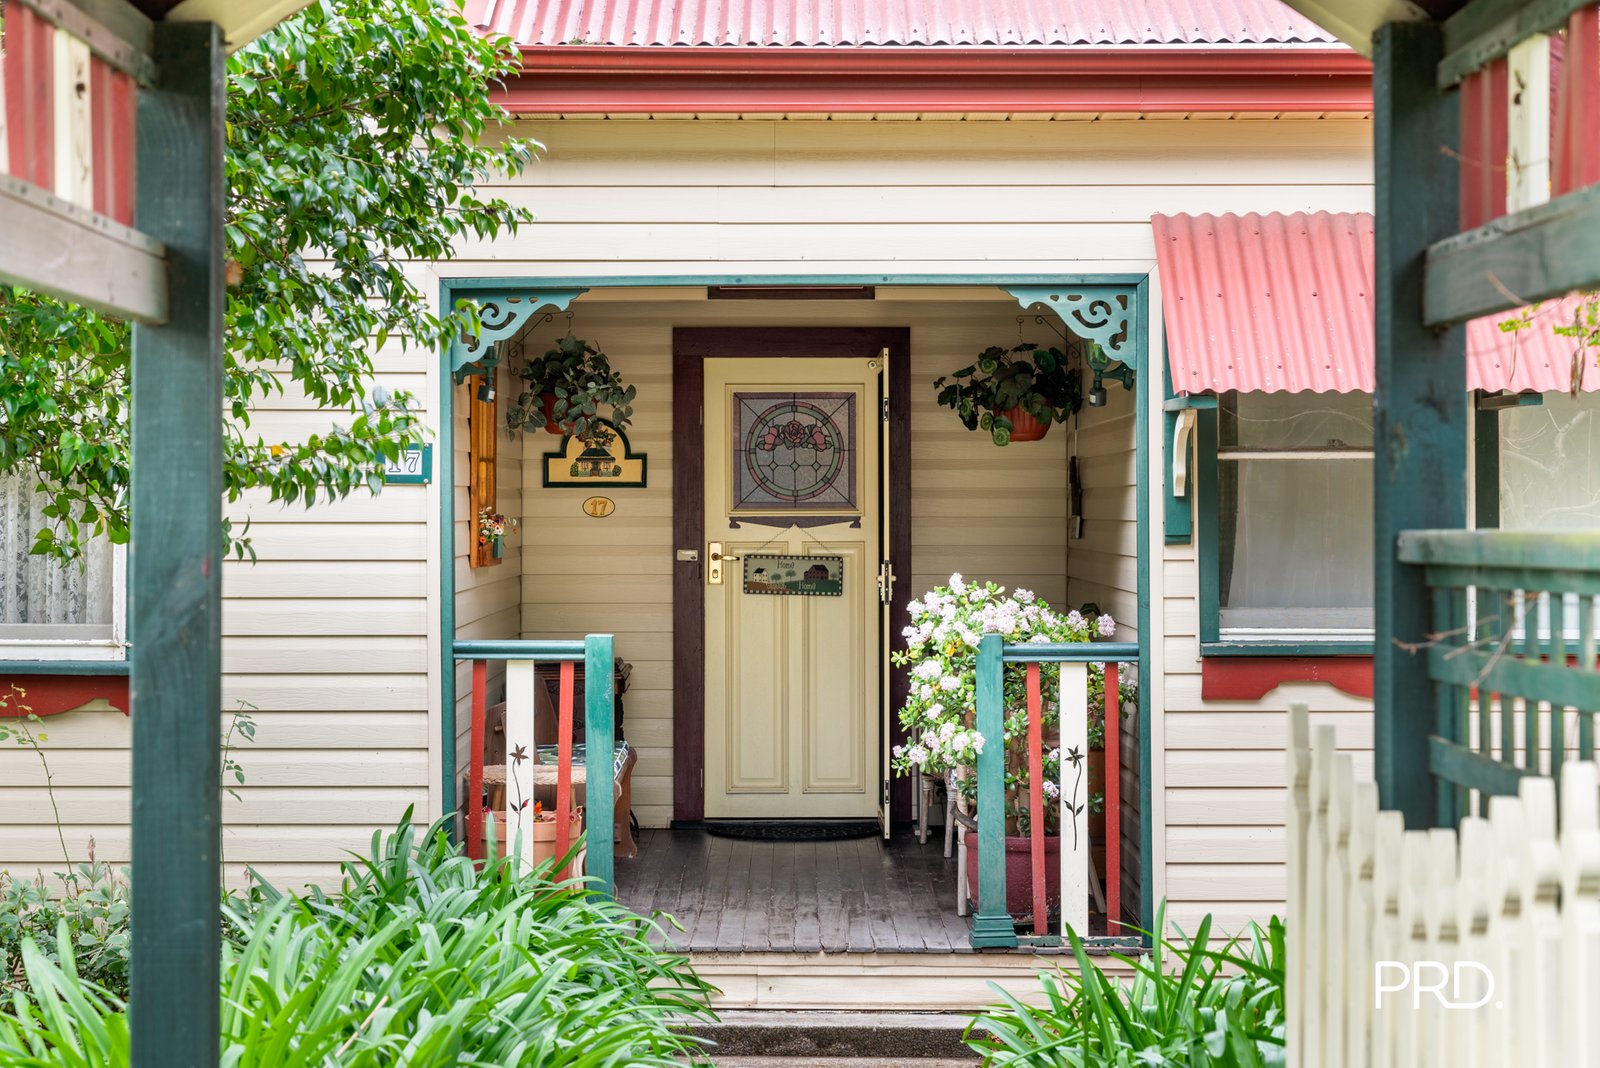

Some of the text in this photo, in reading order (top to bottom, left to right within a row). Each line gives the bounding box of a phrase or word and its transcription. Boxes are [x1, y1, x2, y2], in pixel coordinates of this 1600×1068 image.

[590, 499, 608, 515] 17
[777, 560, 795, 569] Home
[798, 581, 816, 590] Home
